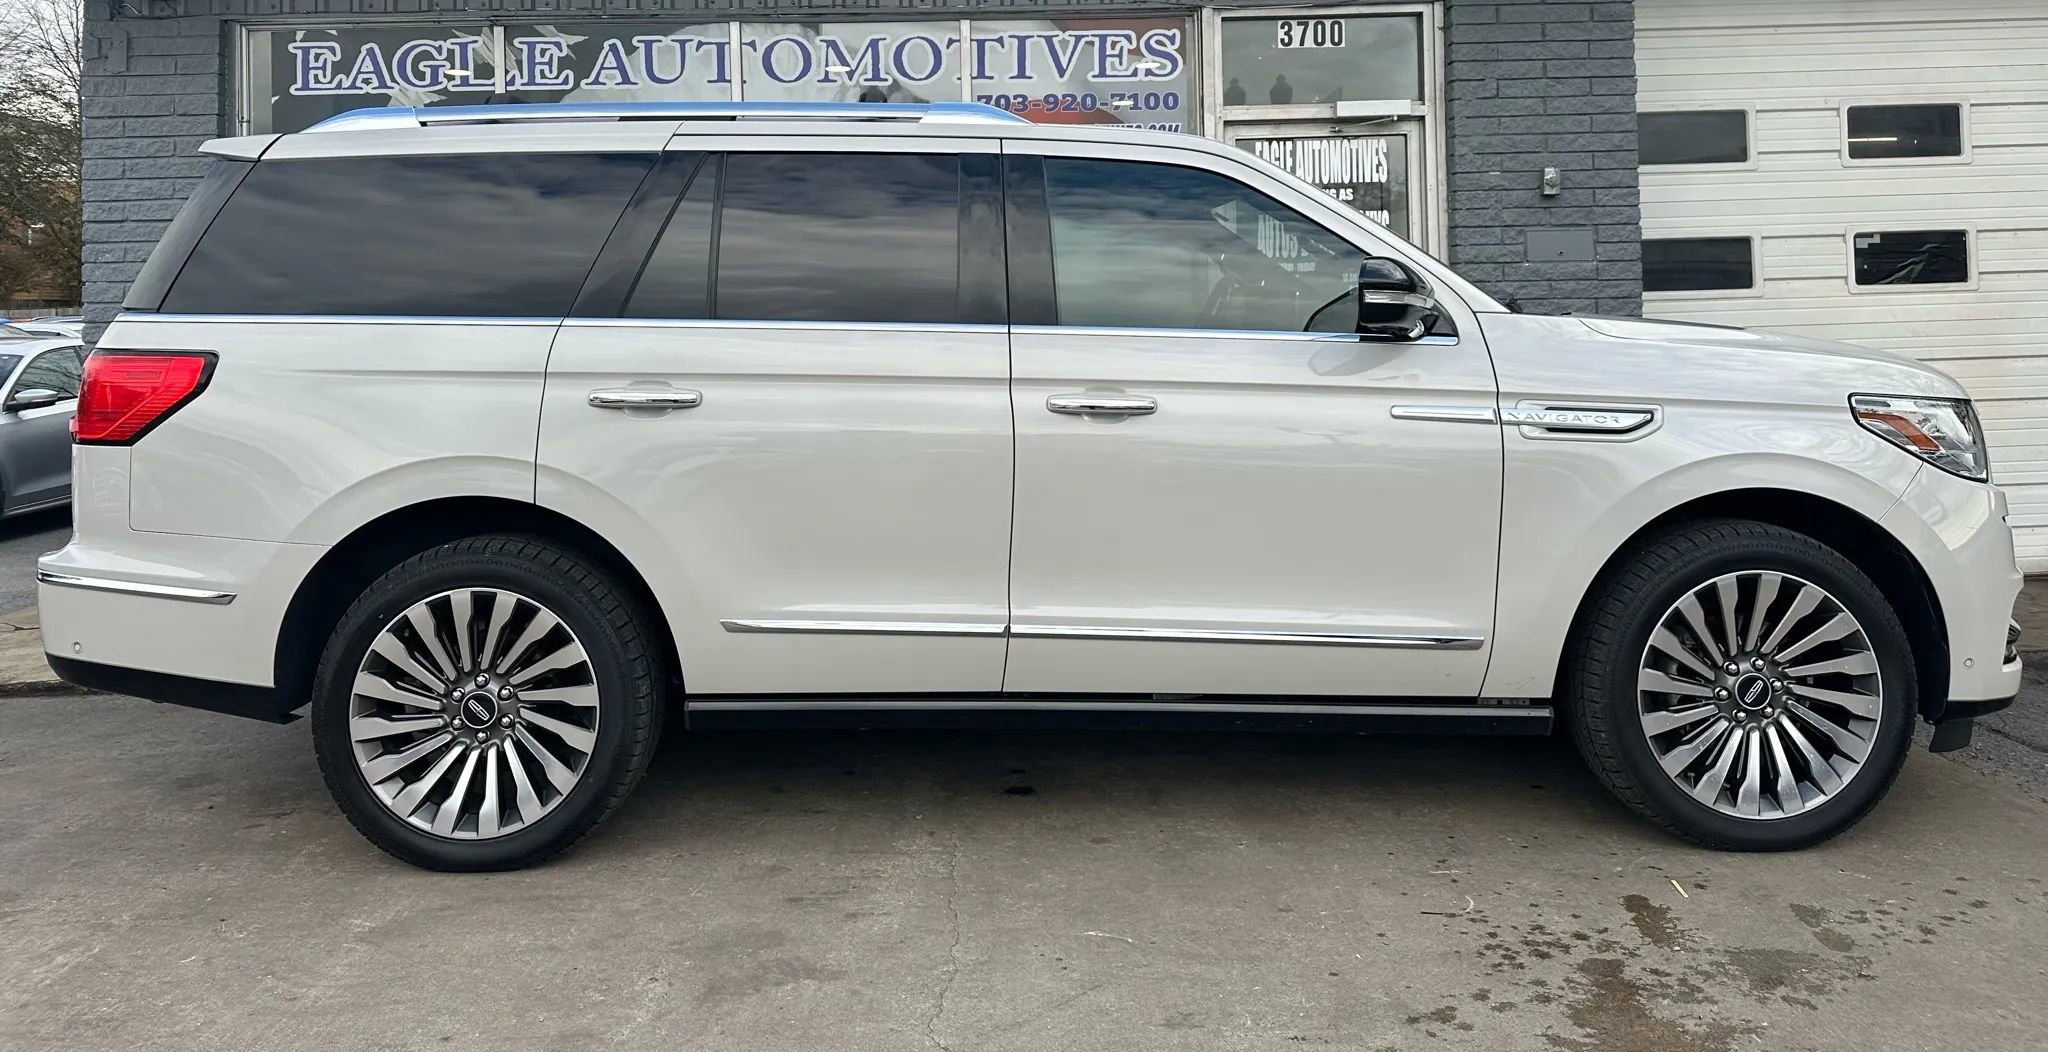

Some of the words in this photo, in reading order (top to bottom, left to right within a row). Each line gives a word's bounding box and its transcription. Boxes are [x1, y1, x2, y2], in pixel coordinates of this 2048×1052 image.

[1279, 19, 1344, 47] 3700
[290, 38, 573, 94] EAGLE
[582, 30, 1182, 88] AUTOMOTIVES
[976, 91, 1181, 113] 703-920-7100
[1295, 138, 1388, 184] AUTOMOTIVES
[1338, 188, 1354, 200] AS
[1508, 411, 1619, 425] NAVIGATOR
